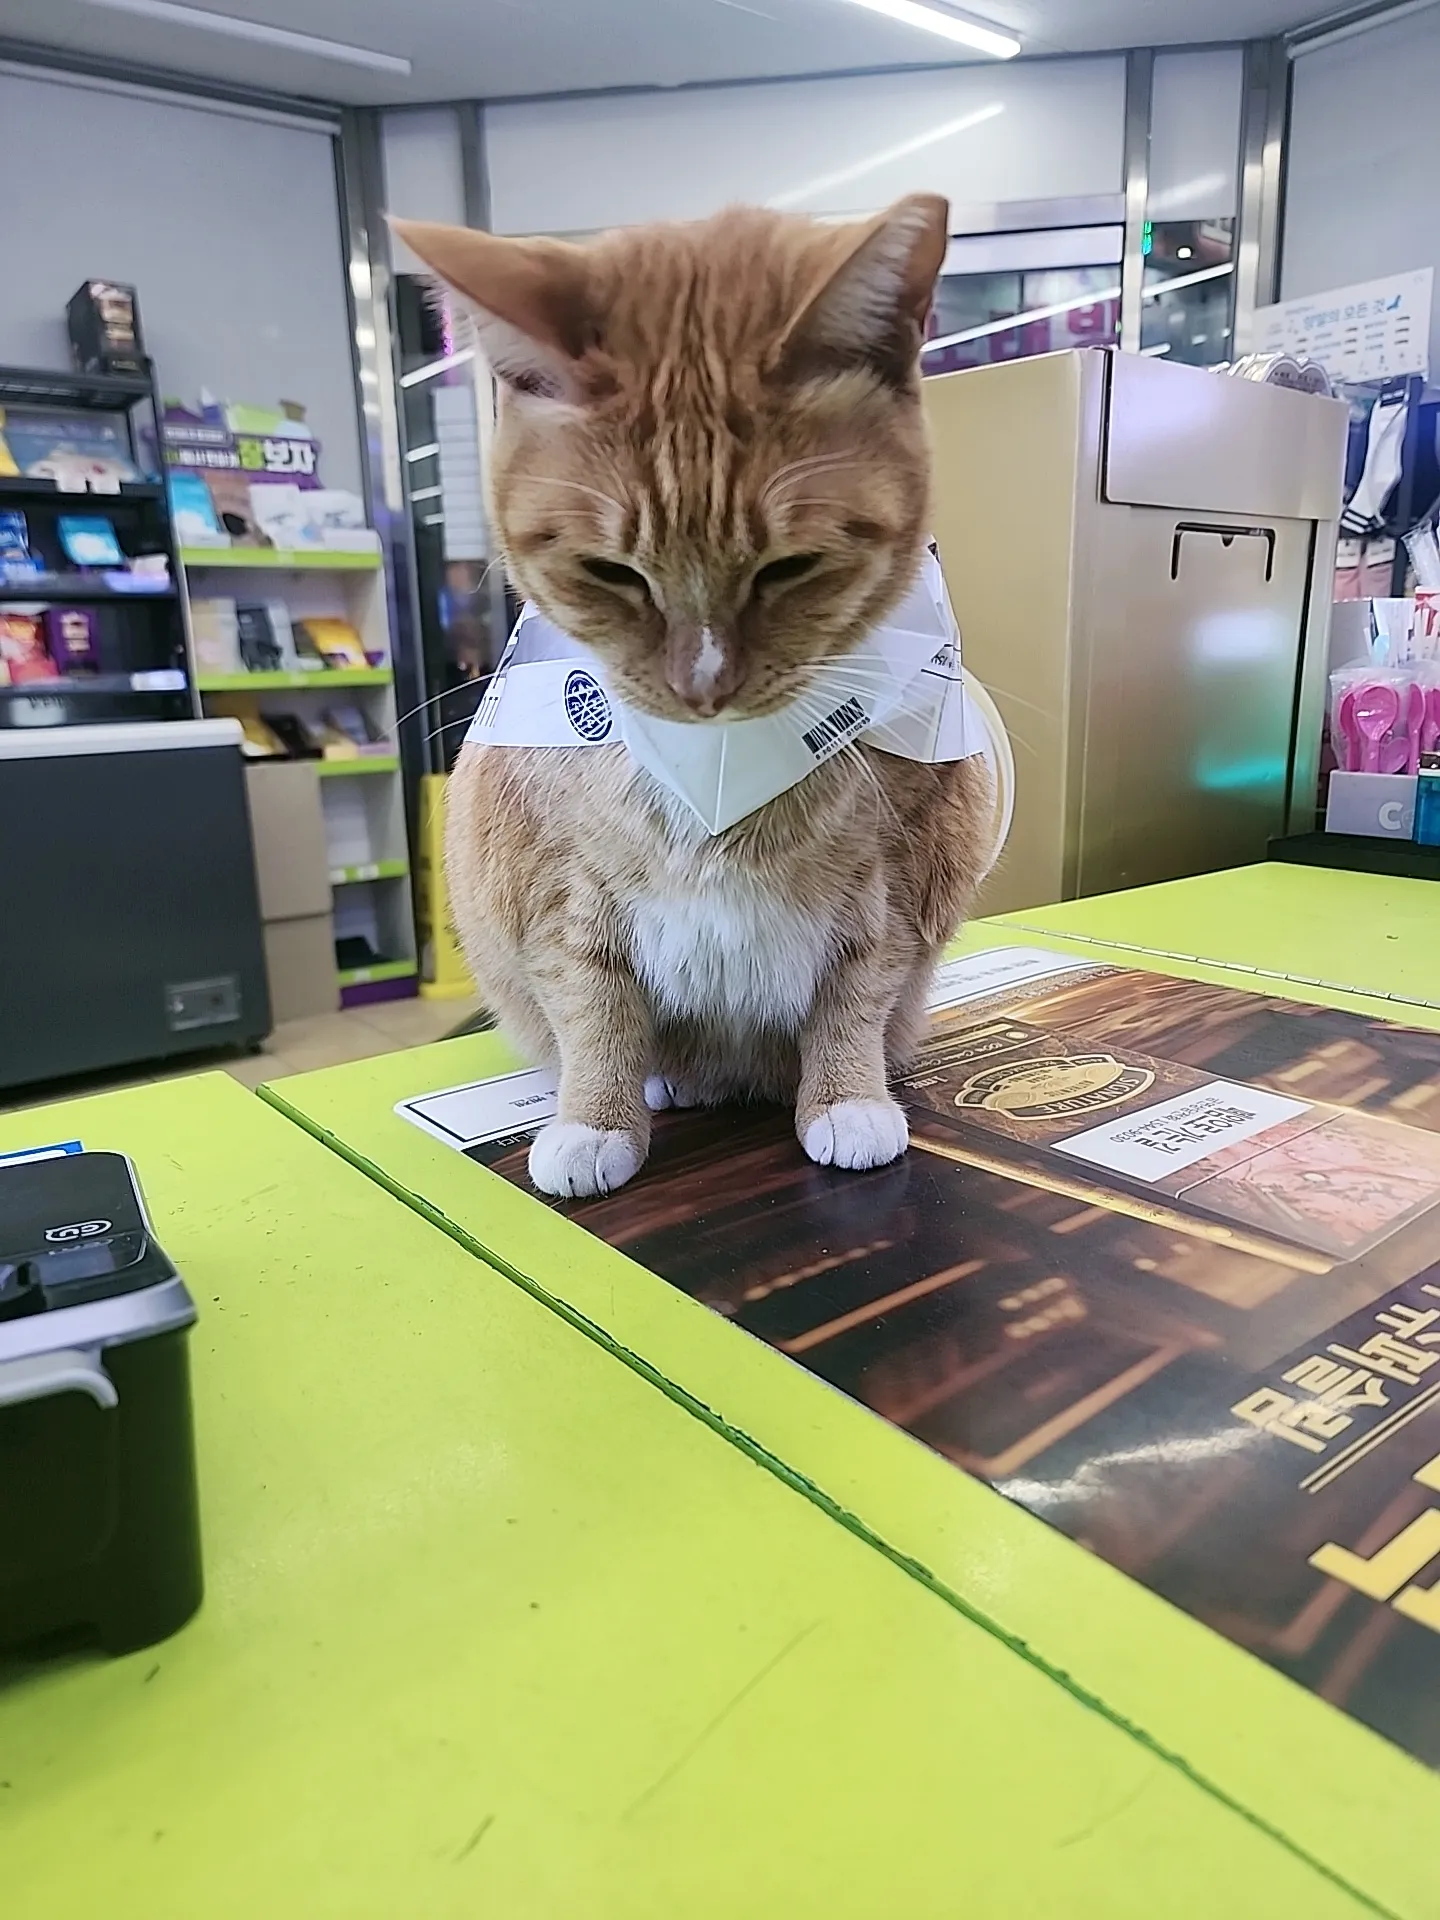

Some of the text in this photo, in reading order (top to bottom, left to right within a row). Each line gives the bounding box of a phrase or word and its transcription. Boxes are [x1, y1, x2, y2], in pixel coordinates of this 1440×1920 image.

[903, 1075, 949, 1090] 1mg
[1035, 1076, 1141, 1114] SIGNATURE
[1109, 1115, 1169, 1143] 1544-9030
[1151, 1126, 1208, 1143] 가는
[1132, 1136, 1182, 1155] 길
